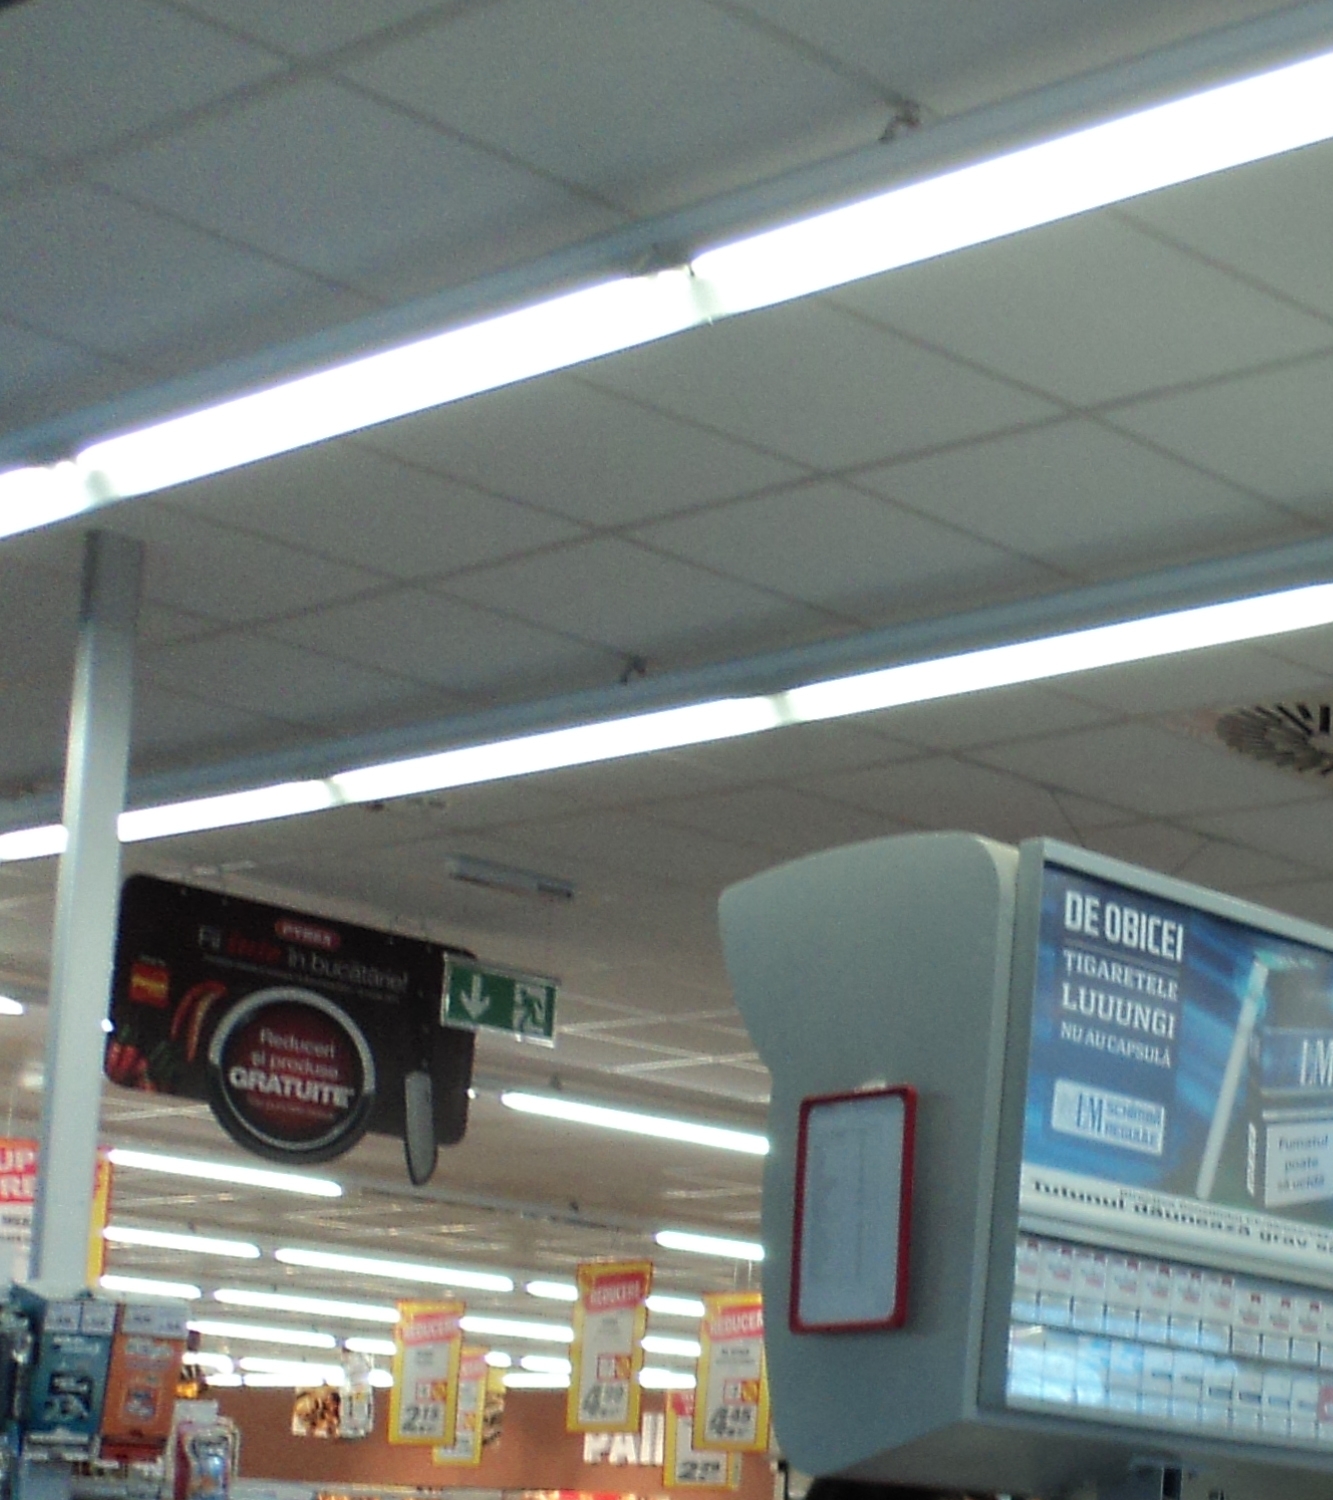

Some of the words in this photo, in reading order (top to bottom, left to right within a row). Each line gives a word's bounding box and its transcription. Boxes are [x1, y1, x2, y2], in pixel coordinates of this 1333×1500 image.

[1064, 890, 1100, 937] DE
[1104, 902, 1184, 963] OBICEI
[1060, 981, 1176, 1041] LUUUNGI
[1060, 1020, 1083, 1043] NU
[1083, 1027, 1106, 1051] AU
